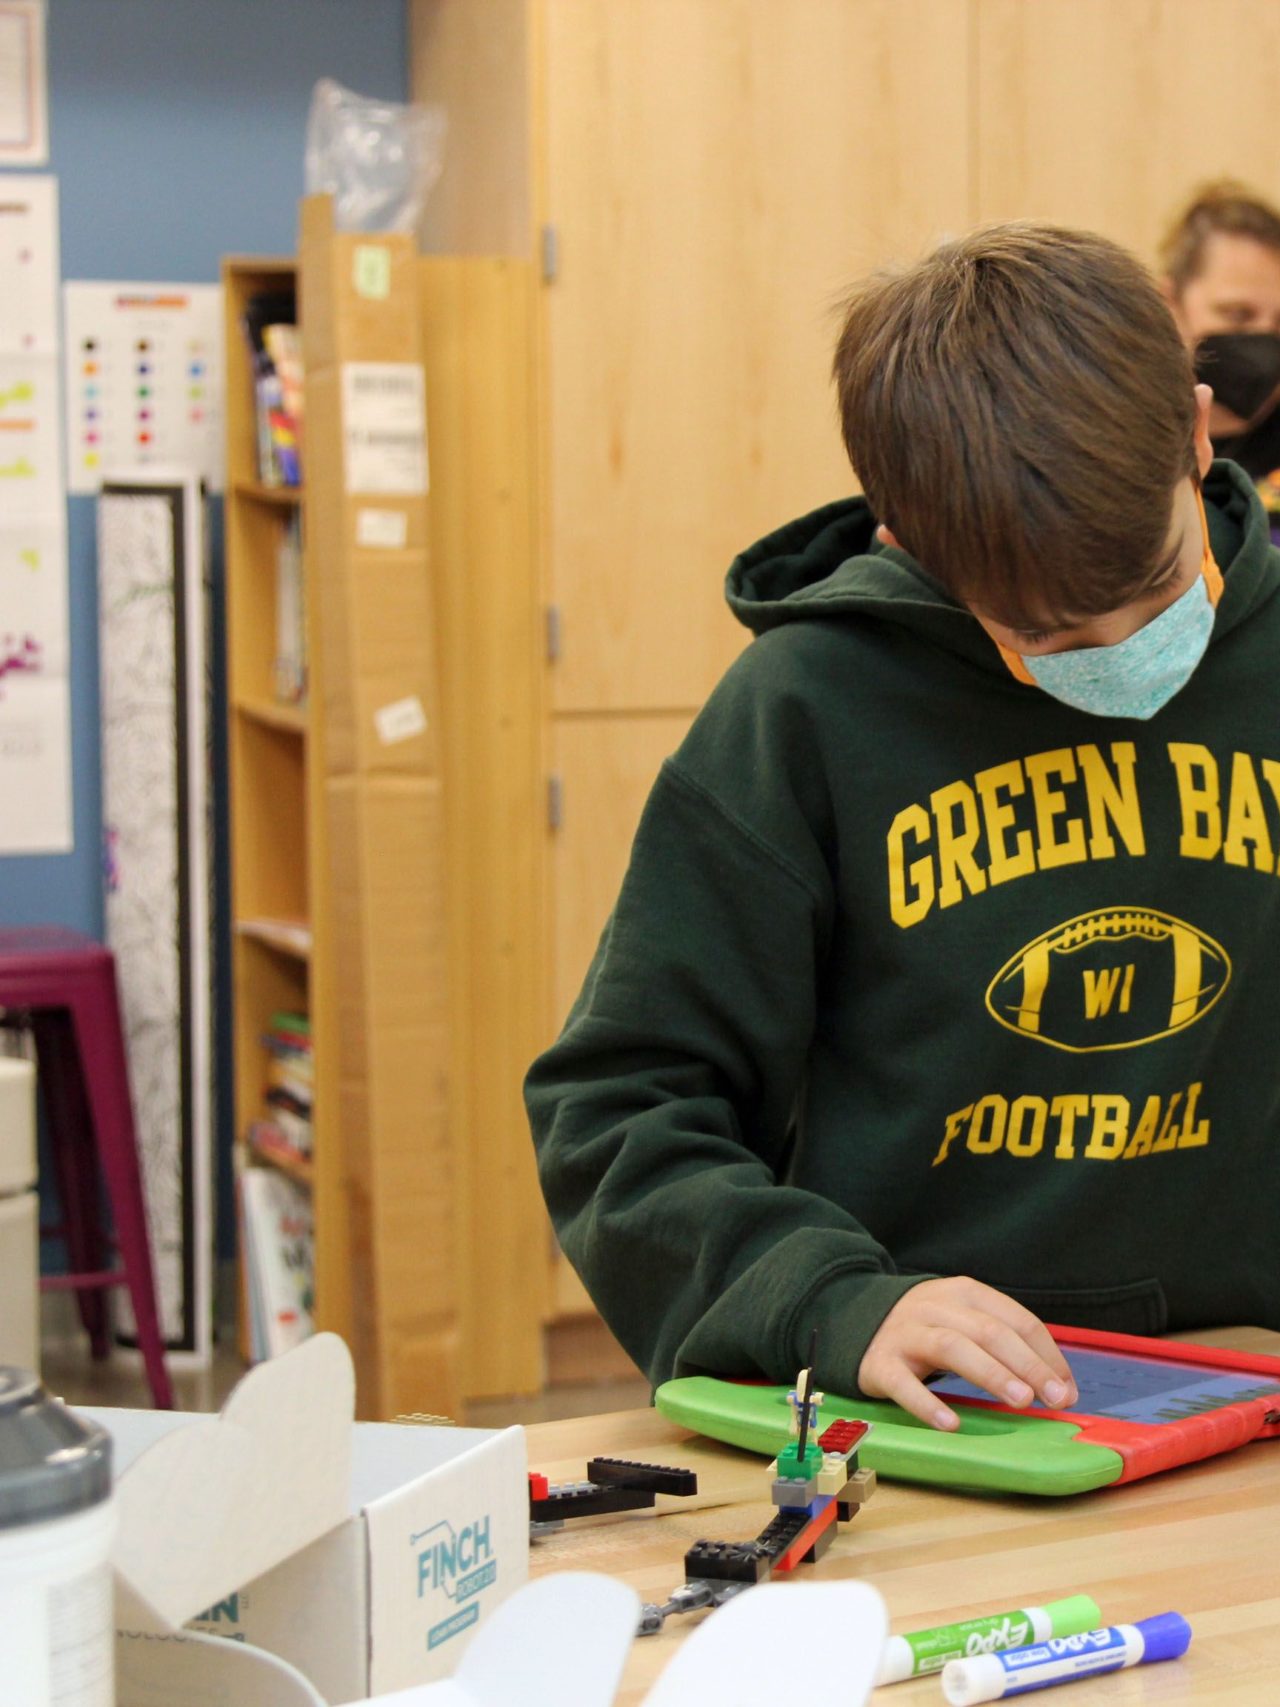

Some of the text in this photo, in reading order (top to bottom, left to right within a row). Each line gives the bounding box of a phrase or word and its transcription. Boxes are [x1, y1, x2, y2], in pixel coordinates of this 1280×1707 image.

[887, 741, 1146, 929] GREEN
[1083, 964, 1135, 1020] WI
[931, 1081, 1209, 1168] FOOTBALL
[417, 1514, 490, 1598] FINCH
[966, 1617, 1028, 1657] EXPO
[1048, 1627, 1111, 1656] EXPO
